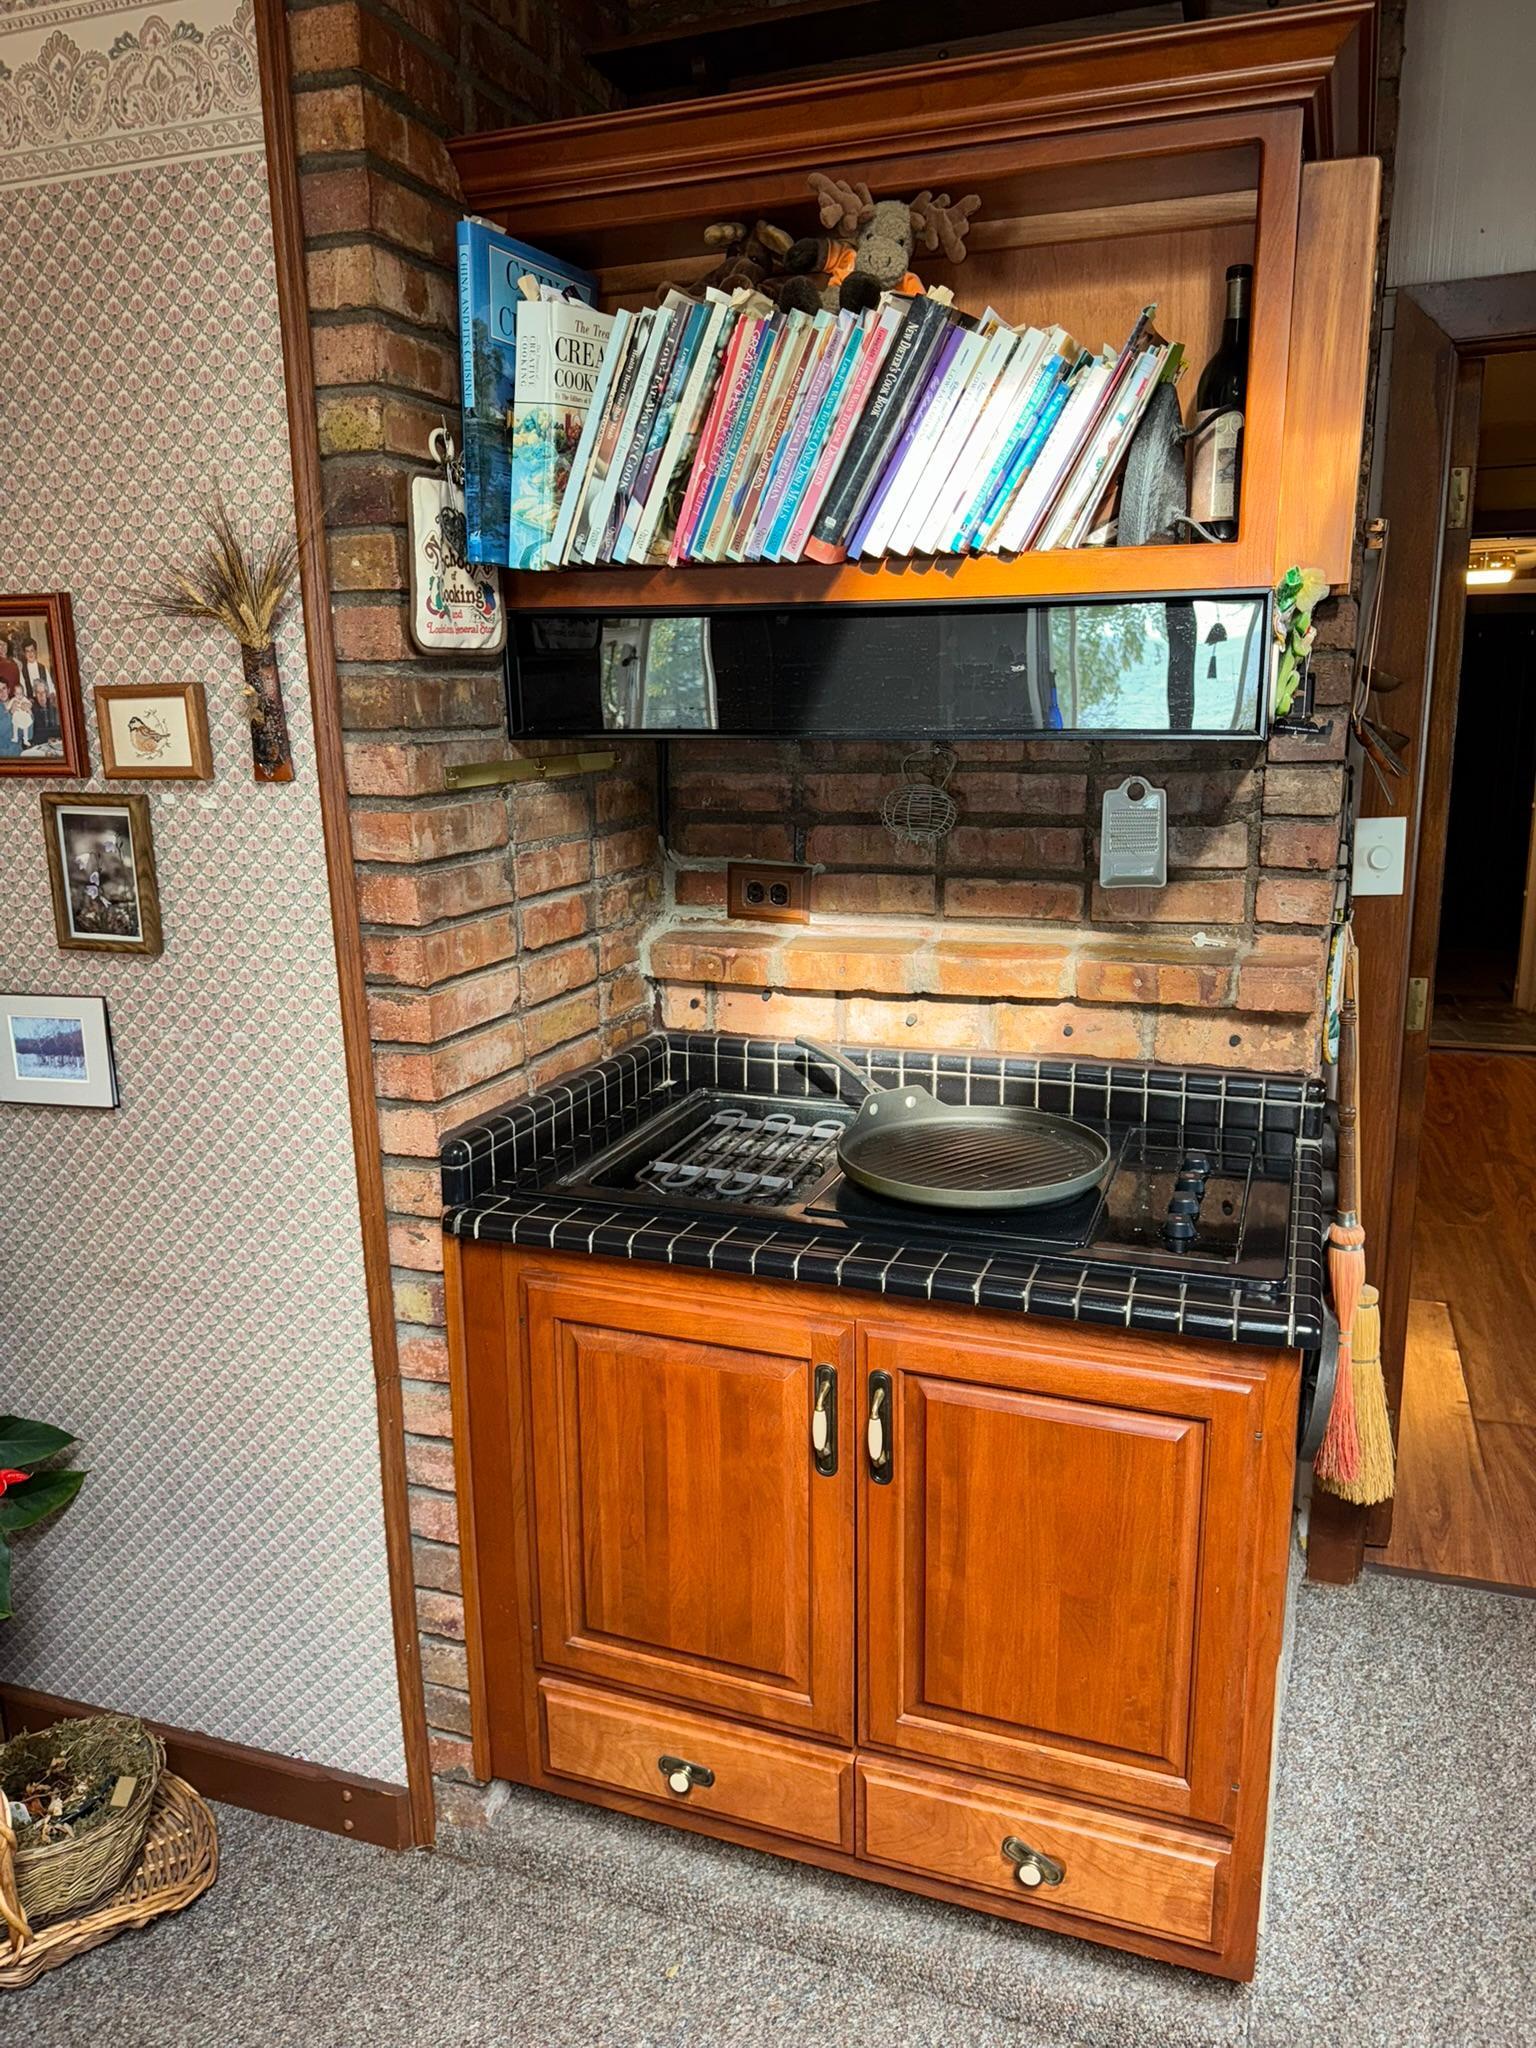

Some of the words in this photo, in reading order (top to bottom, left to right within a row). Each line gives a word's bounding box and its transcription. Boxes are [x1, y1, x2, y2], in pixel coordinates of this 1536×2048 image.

[459, 252, 469, 292] CHINA
[460, 296, 470, 324] AND
[461, 327, 471, 346] ITS
[575, 320, 590, 335] The
[594, 325, 610, 340] Trea
[902, 321, 918, 341] NEW
[520, 335, 528, 387] COOKING
[555, 337, 605, 368] CREA
[625, 348, 638, 373] Healthy
[742, 329, 761, 365] GREAT
[888, 339, 911, 374] DIETER'S
[462, 350, 473, 399] CUISINE
[555, 370, 597, 392] COOK
[620, 373, 631, 392] Heart
[726, 367, 748, 412] RECIPES
[879, 372, 897, 396] COOK
[870, 394, 887, 418] BOOK
[619, 453, 638, 490] COOK
[719, 450, 735, 478] PASTA
[752, 448, 775, 491] CHICKEN
[769, 445, 797, 501] VEGETARIAN
[793, 440, 819, 489] ONE-DISH
[812, 443, 838, 487] DESSERTS
[780, 488, 800, 521] MEALS
[442, 584, 484, 611] ooking
